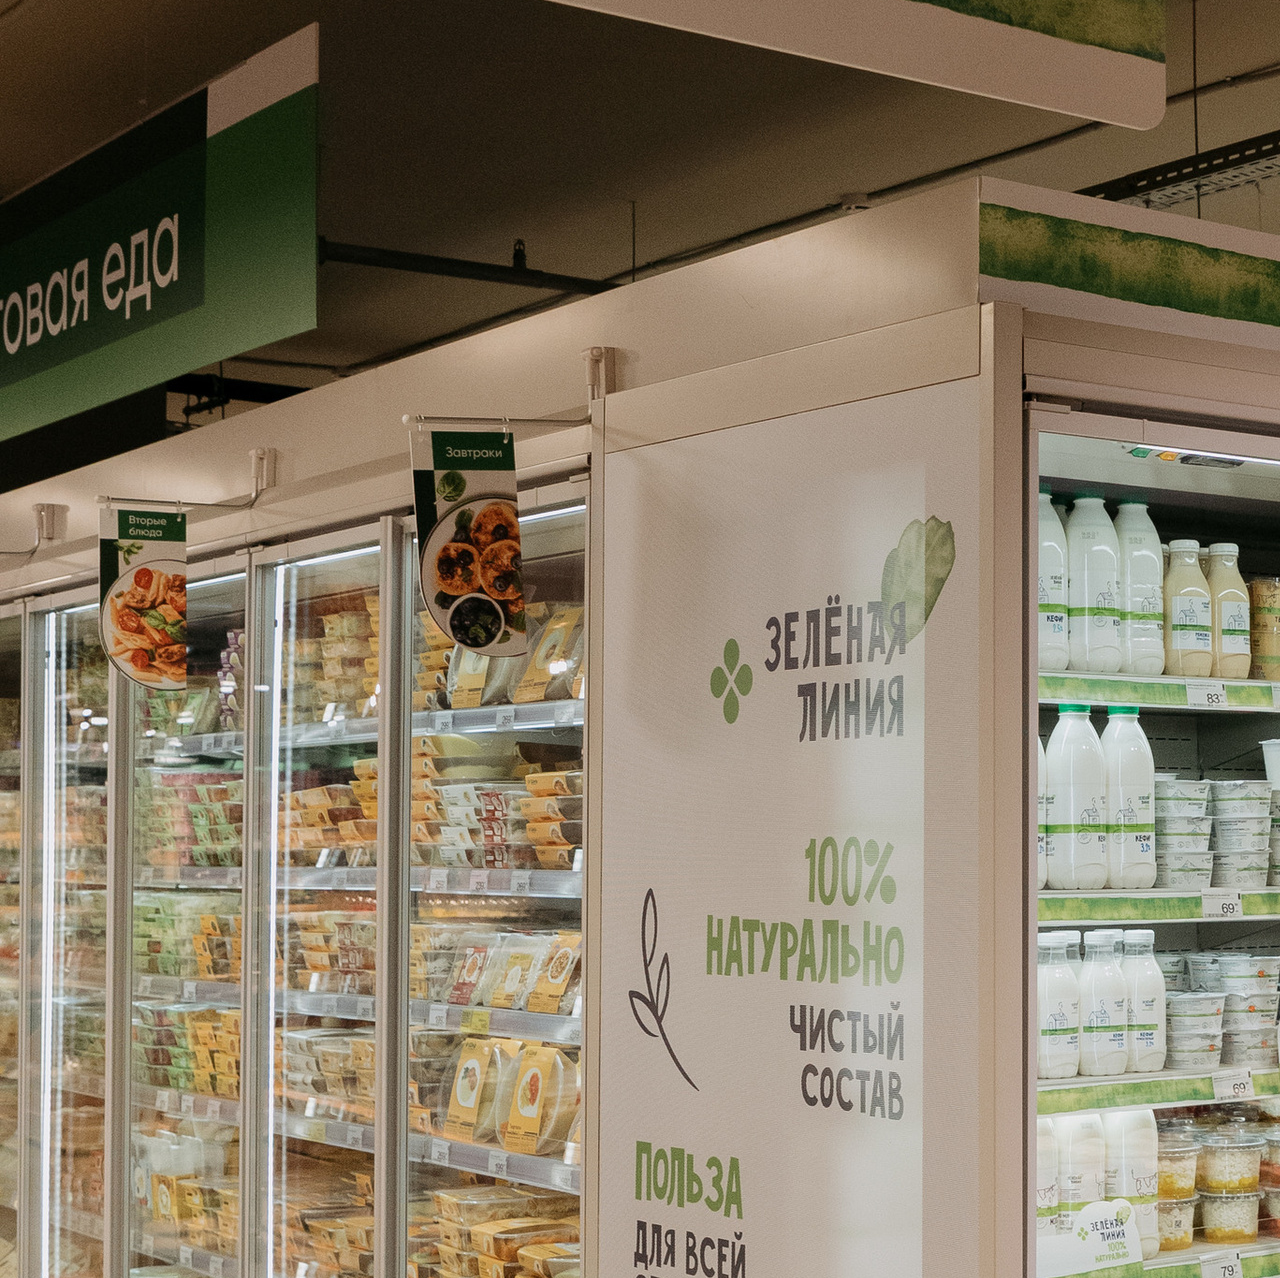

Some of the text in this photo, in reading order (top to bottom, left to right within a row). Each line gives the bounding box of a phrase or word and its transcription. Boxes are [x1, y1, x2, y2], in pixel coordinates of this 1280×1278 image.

[0, 212, 179, 355] овая еда
[445, 446, 503, 460] Завтраки
[128, 515, 167, 526] Вторые
[128, 526, 163, 537] блюда
[764, 593, 907, 673] ЗЕЛЁНАЯ
[1206, 693, 1221, 704] 83
[797, 675, 904, 743] ЛИНИЯ
[804, 836, 897, 907] 100%
[1221, 902, 1235, 914] 69
[706, 915, 905, 987] НАТУРАЛЬНО
[789, 1001, 905, 1061] ЧИСТЫЙ
[800, 1063, 905, 1122] СОСТАВ
[1232, 1083, 1247, 1095] 69
[634, 1140, 744, 1220] ПОЛЬЗА
[1090, 1218, 1125, 1232] ЗЕЛЁНАЯ
[1100, 1228, 1126, 1242] ЛИНИЯ
[633, 1220, 677, 1271] ДЛЯ
[1107, 1241, 1127, 1252] 100%
[1220, 1264, 1235, 1278] 79
